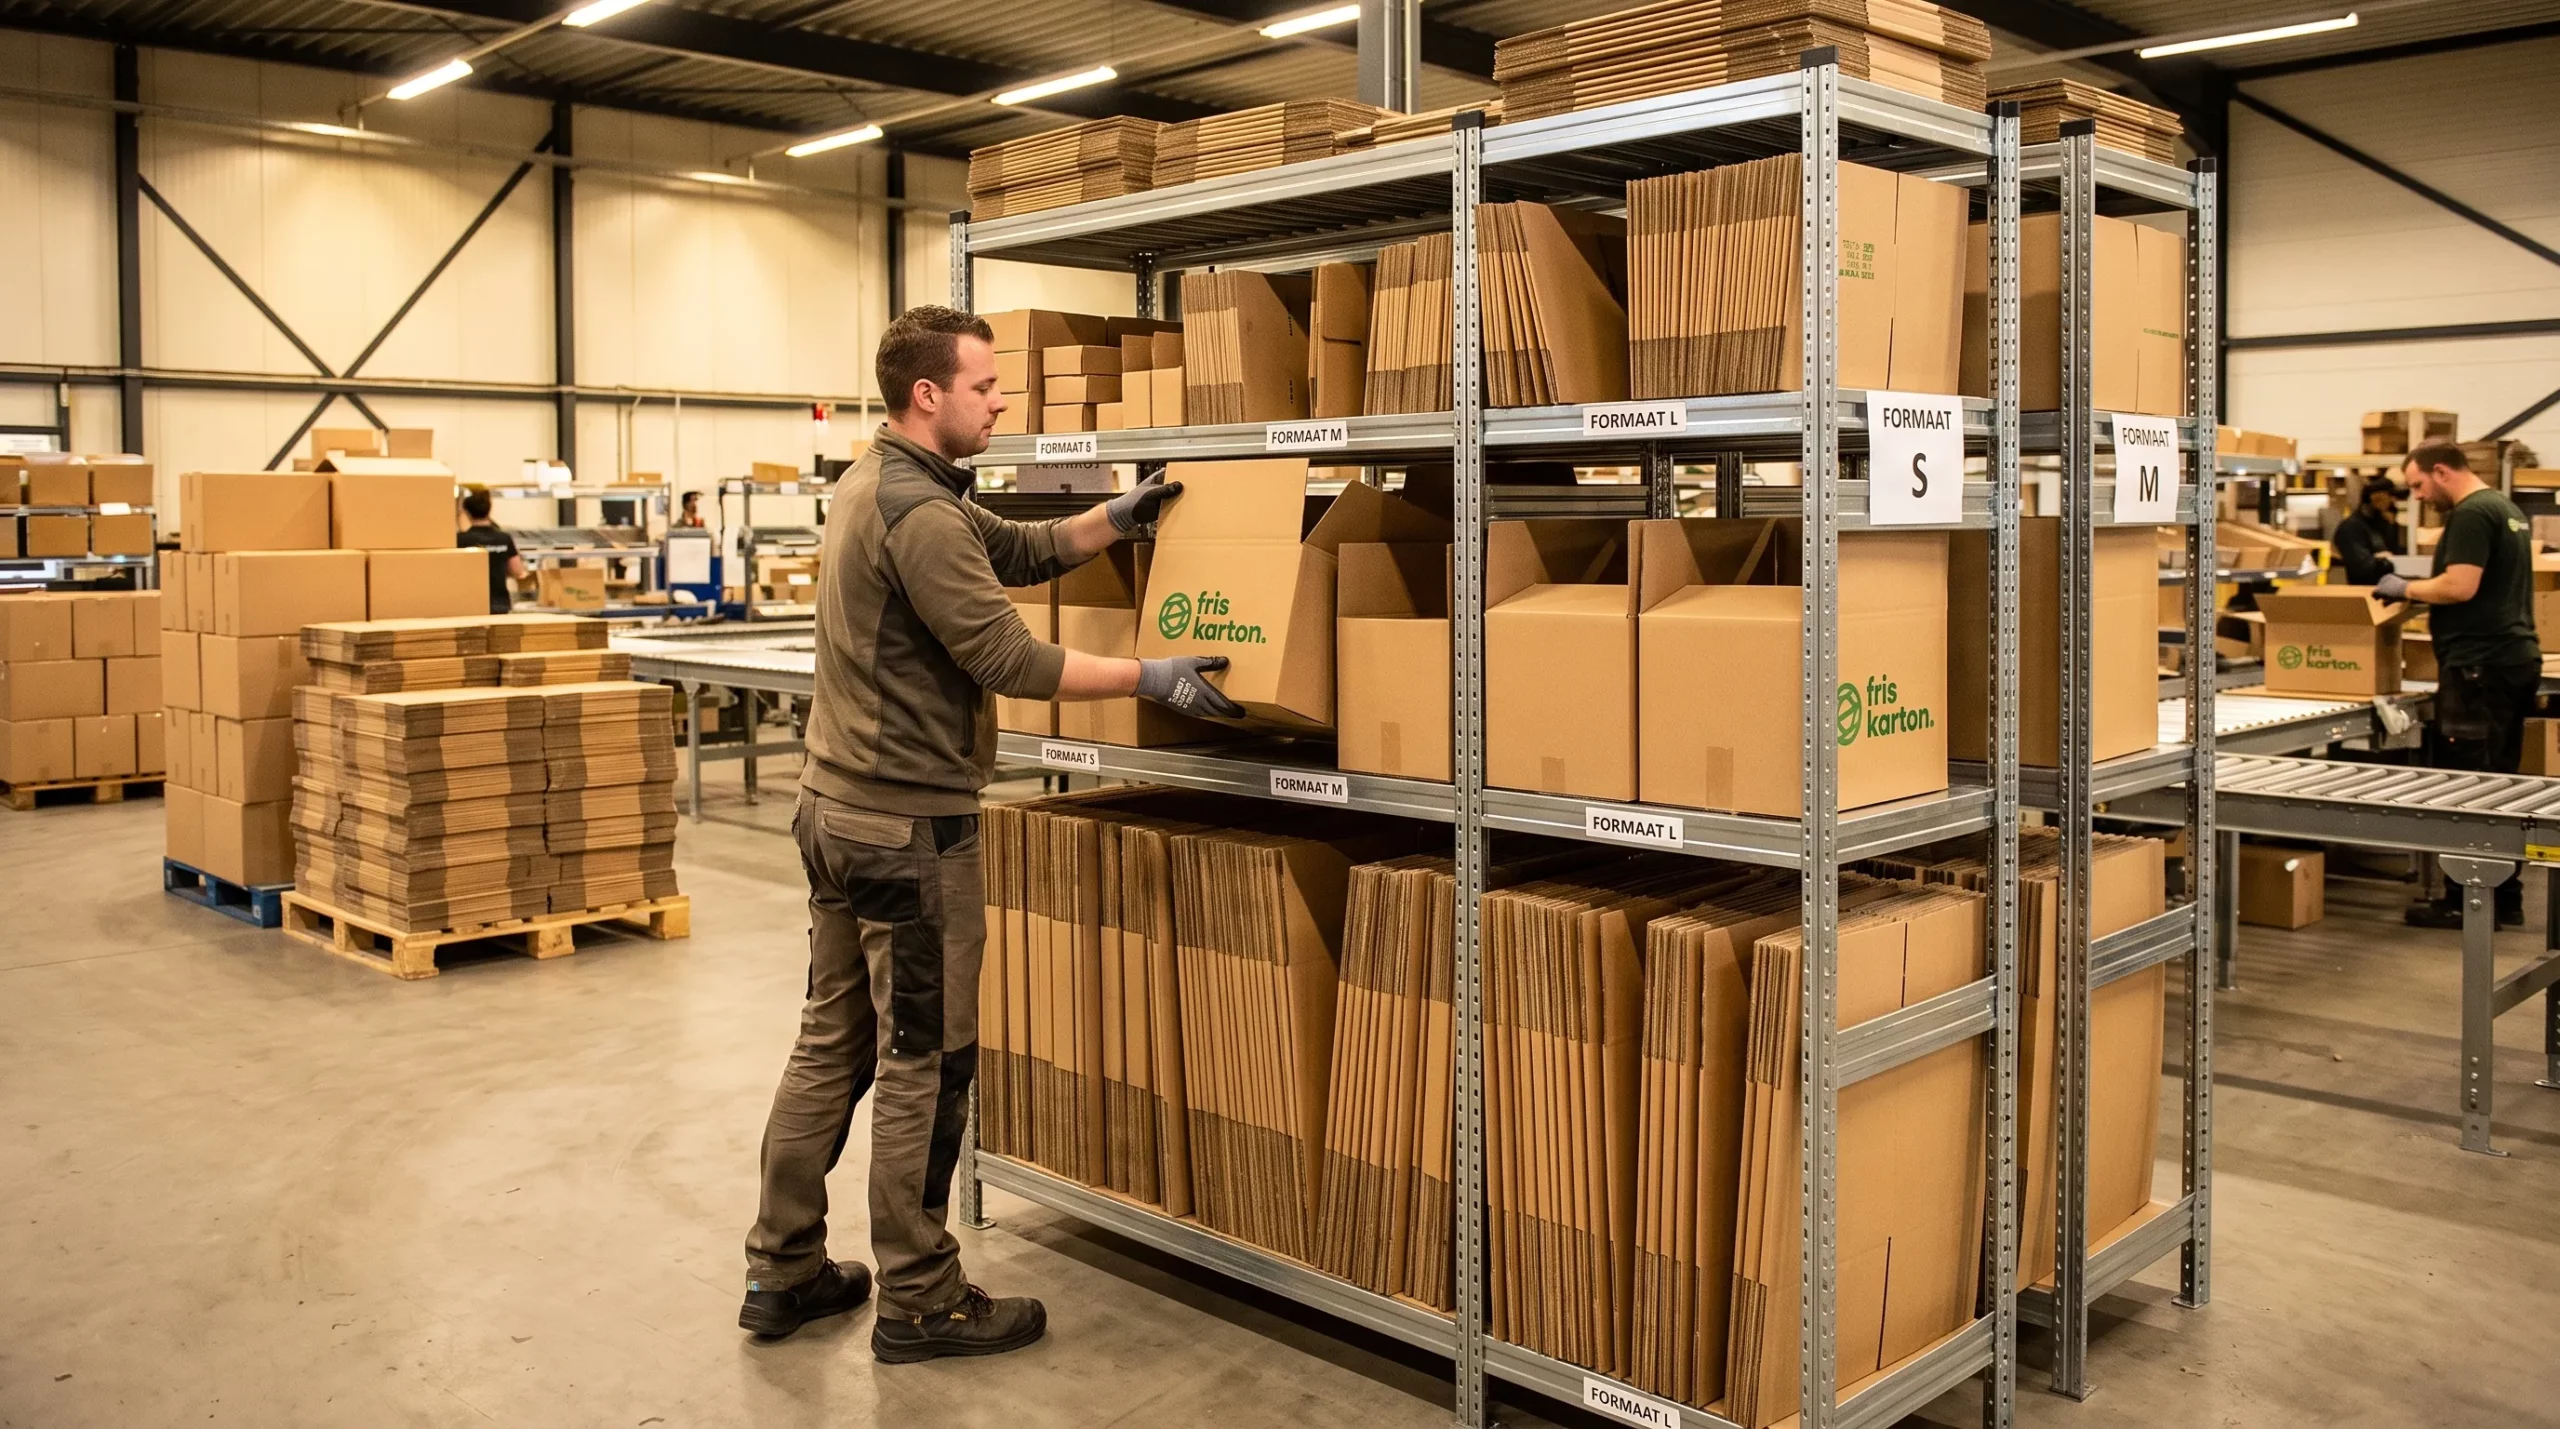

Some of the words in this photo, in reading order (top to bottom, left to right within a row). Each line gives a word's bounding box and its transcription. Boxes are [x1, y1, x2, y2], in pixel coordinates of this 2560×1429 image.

[1591, 411, 1665, 429] FORMAAT
[1670, 411, 1678, 426] L
[1883, 408, 1951, 430] FORMAAT
[1271, 429, 1327, 444] FORMAAT
[1330, 428, 1342, 441] M
[2122, 427, 2169, 447] FORMAAT
[1041, 442, 1084, 455] FORMAAT
[1912, 452, 1928, 498] S
[2139, 465, 2159, 502] M
[1197, 591, 1230, 616] fris
[1192, 616, 1266, 644] karton.
[2306, 645, 2331, 657] fris
[1866, 674, 1897, 707] fris
[1867, 706, 1935, 738] karton.
[1046, 749, 1087, 764] FORMAAT
[1089, 754, 1095, 765] S
[1275, 777, 1328, 795] FORMAAT
[1332, 783, 1342, 796] M
[1593, 816, 1664, 838] FORMAAT
[1669, 825, 1677, 840] L
[1591, 1387, 1660, 1423] FORMAAT
[1664, 1413, 1672, 1428] L
